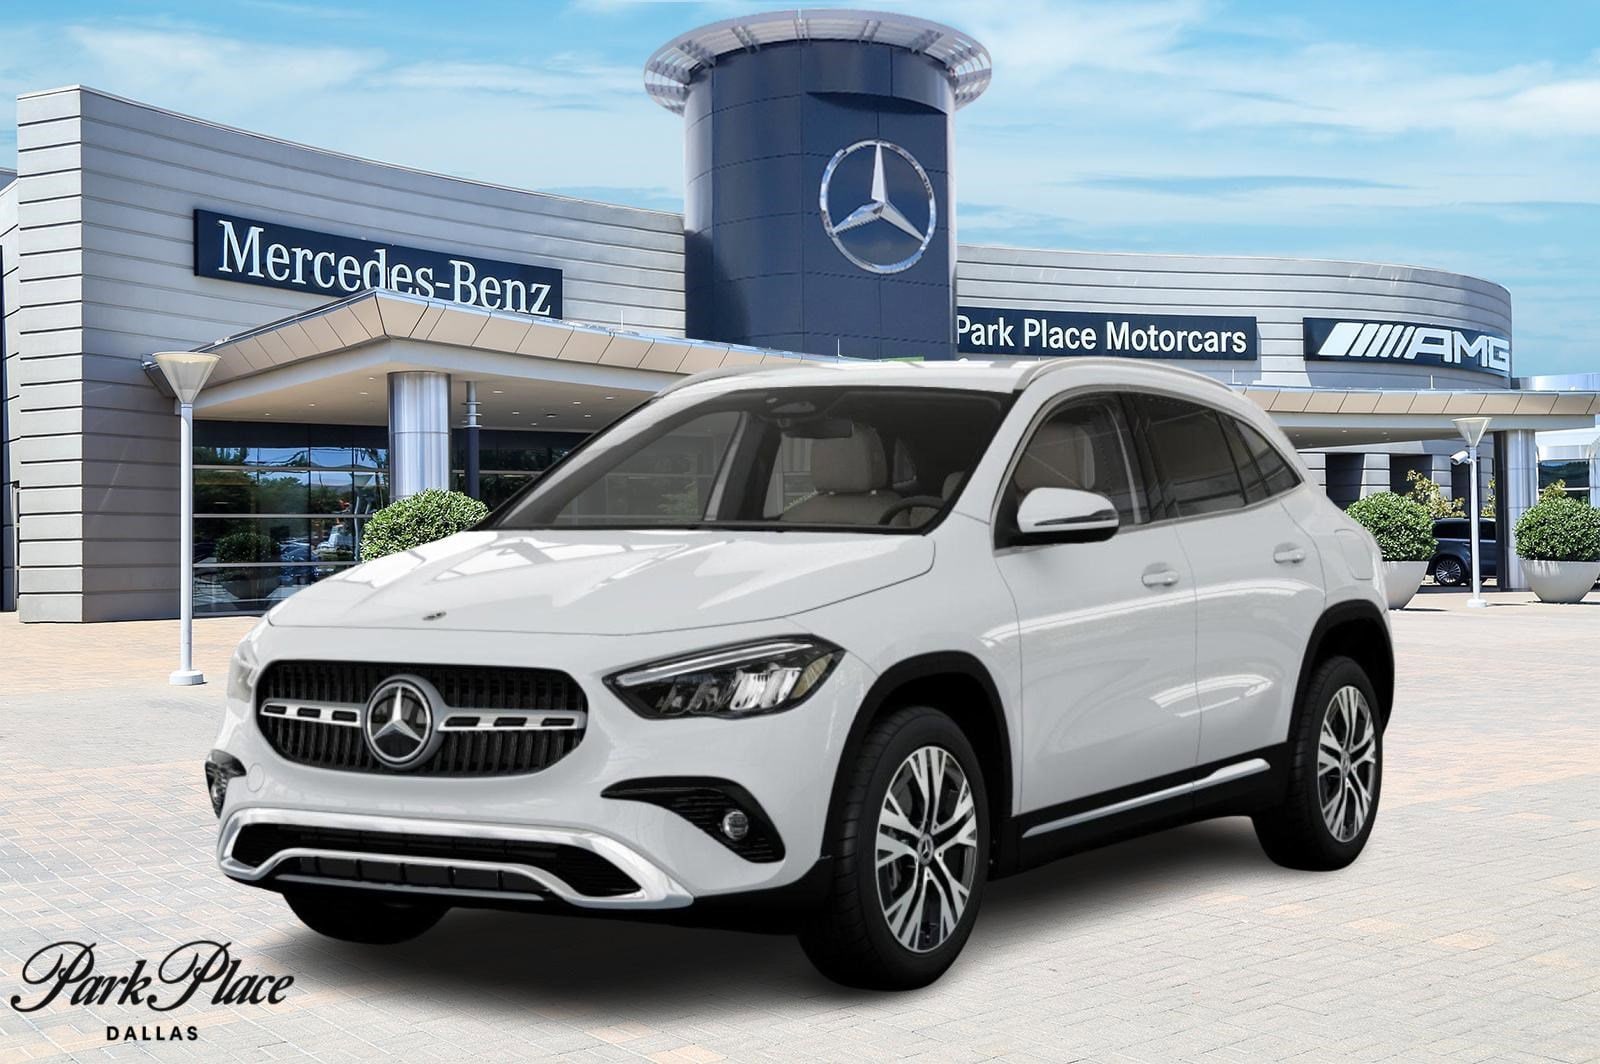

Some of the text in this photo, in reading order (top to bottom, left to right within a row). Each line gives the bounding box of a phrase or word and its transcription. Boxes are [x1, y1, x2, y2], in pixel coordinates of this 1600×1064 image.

[218, 219, 552, 316] Mercedes-Benz
[956, 315, 1248, 354] Park Place Motorcars
[1403, 326, 1510, 372] AMG
